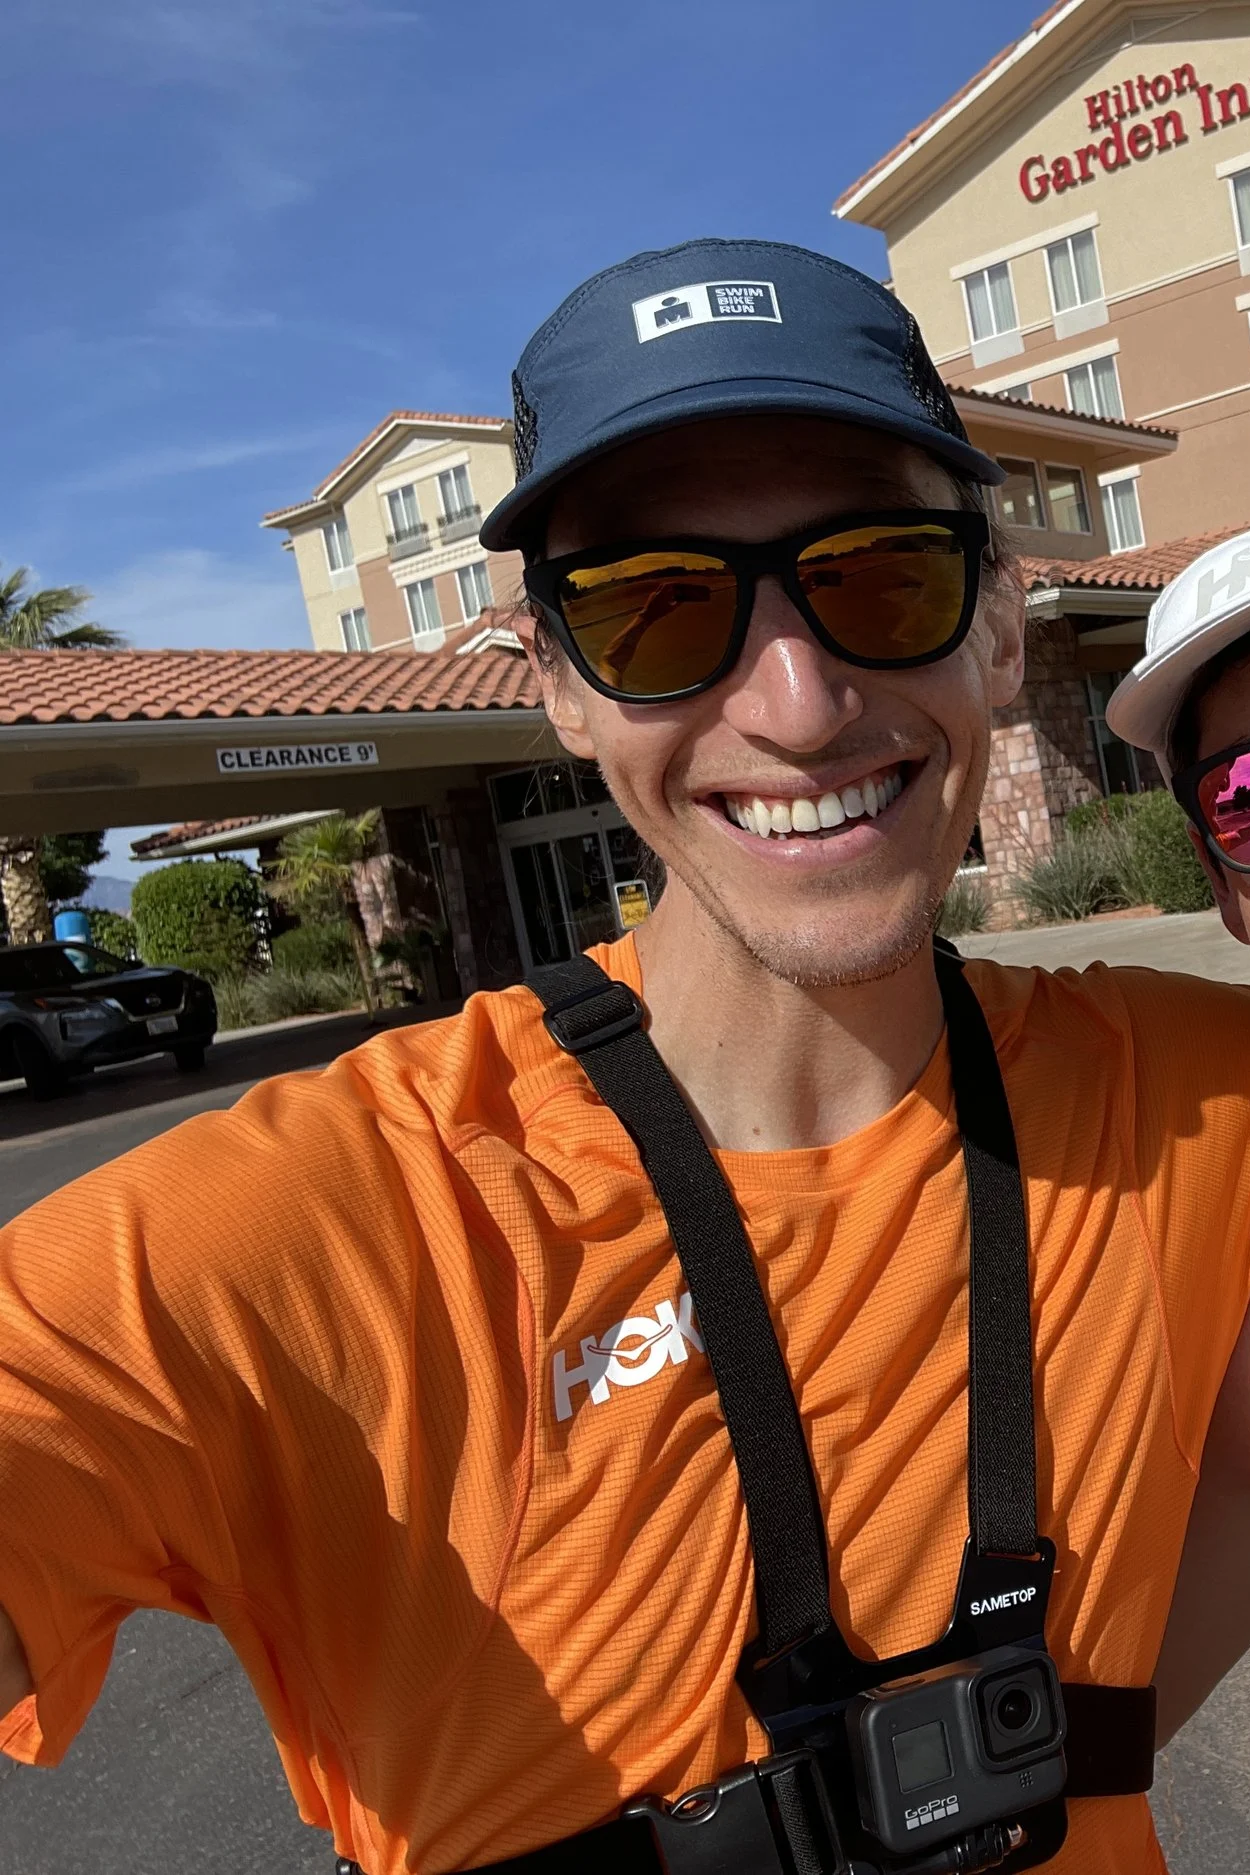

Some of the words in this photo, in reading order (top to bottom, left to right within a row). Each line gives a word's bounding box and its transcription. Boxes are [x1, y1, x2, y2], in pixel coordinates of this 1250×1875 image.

[1084, 63, 1200, 132] Hilton
[1019, 110, 1188, 204] Garden
[715, 287, 764, 297] SWIM
[717, 296, 755, 305] BIKE
[720, 304, 755, 313] RUN
[220, 746, 352, 769] CLEARANCE
[553, 1291, 706, 1422] HOK
[970, 1587, 1037, 1615] SAMETOP
[905, 1795, 958, 1819] GoPro
